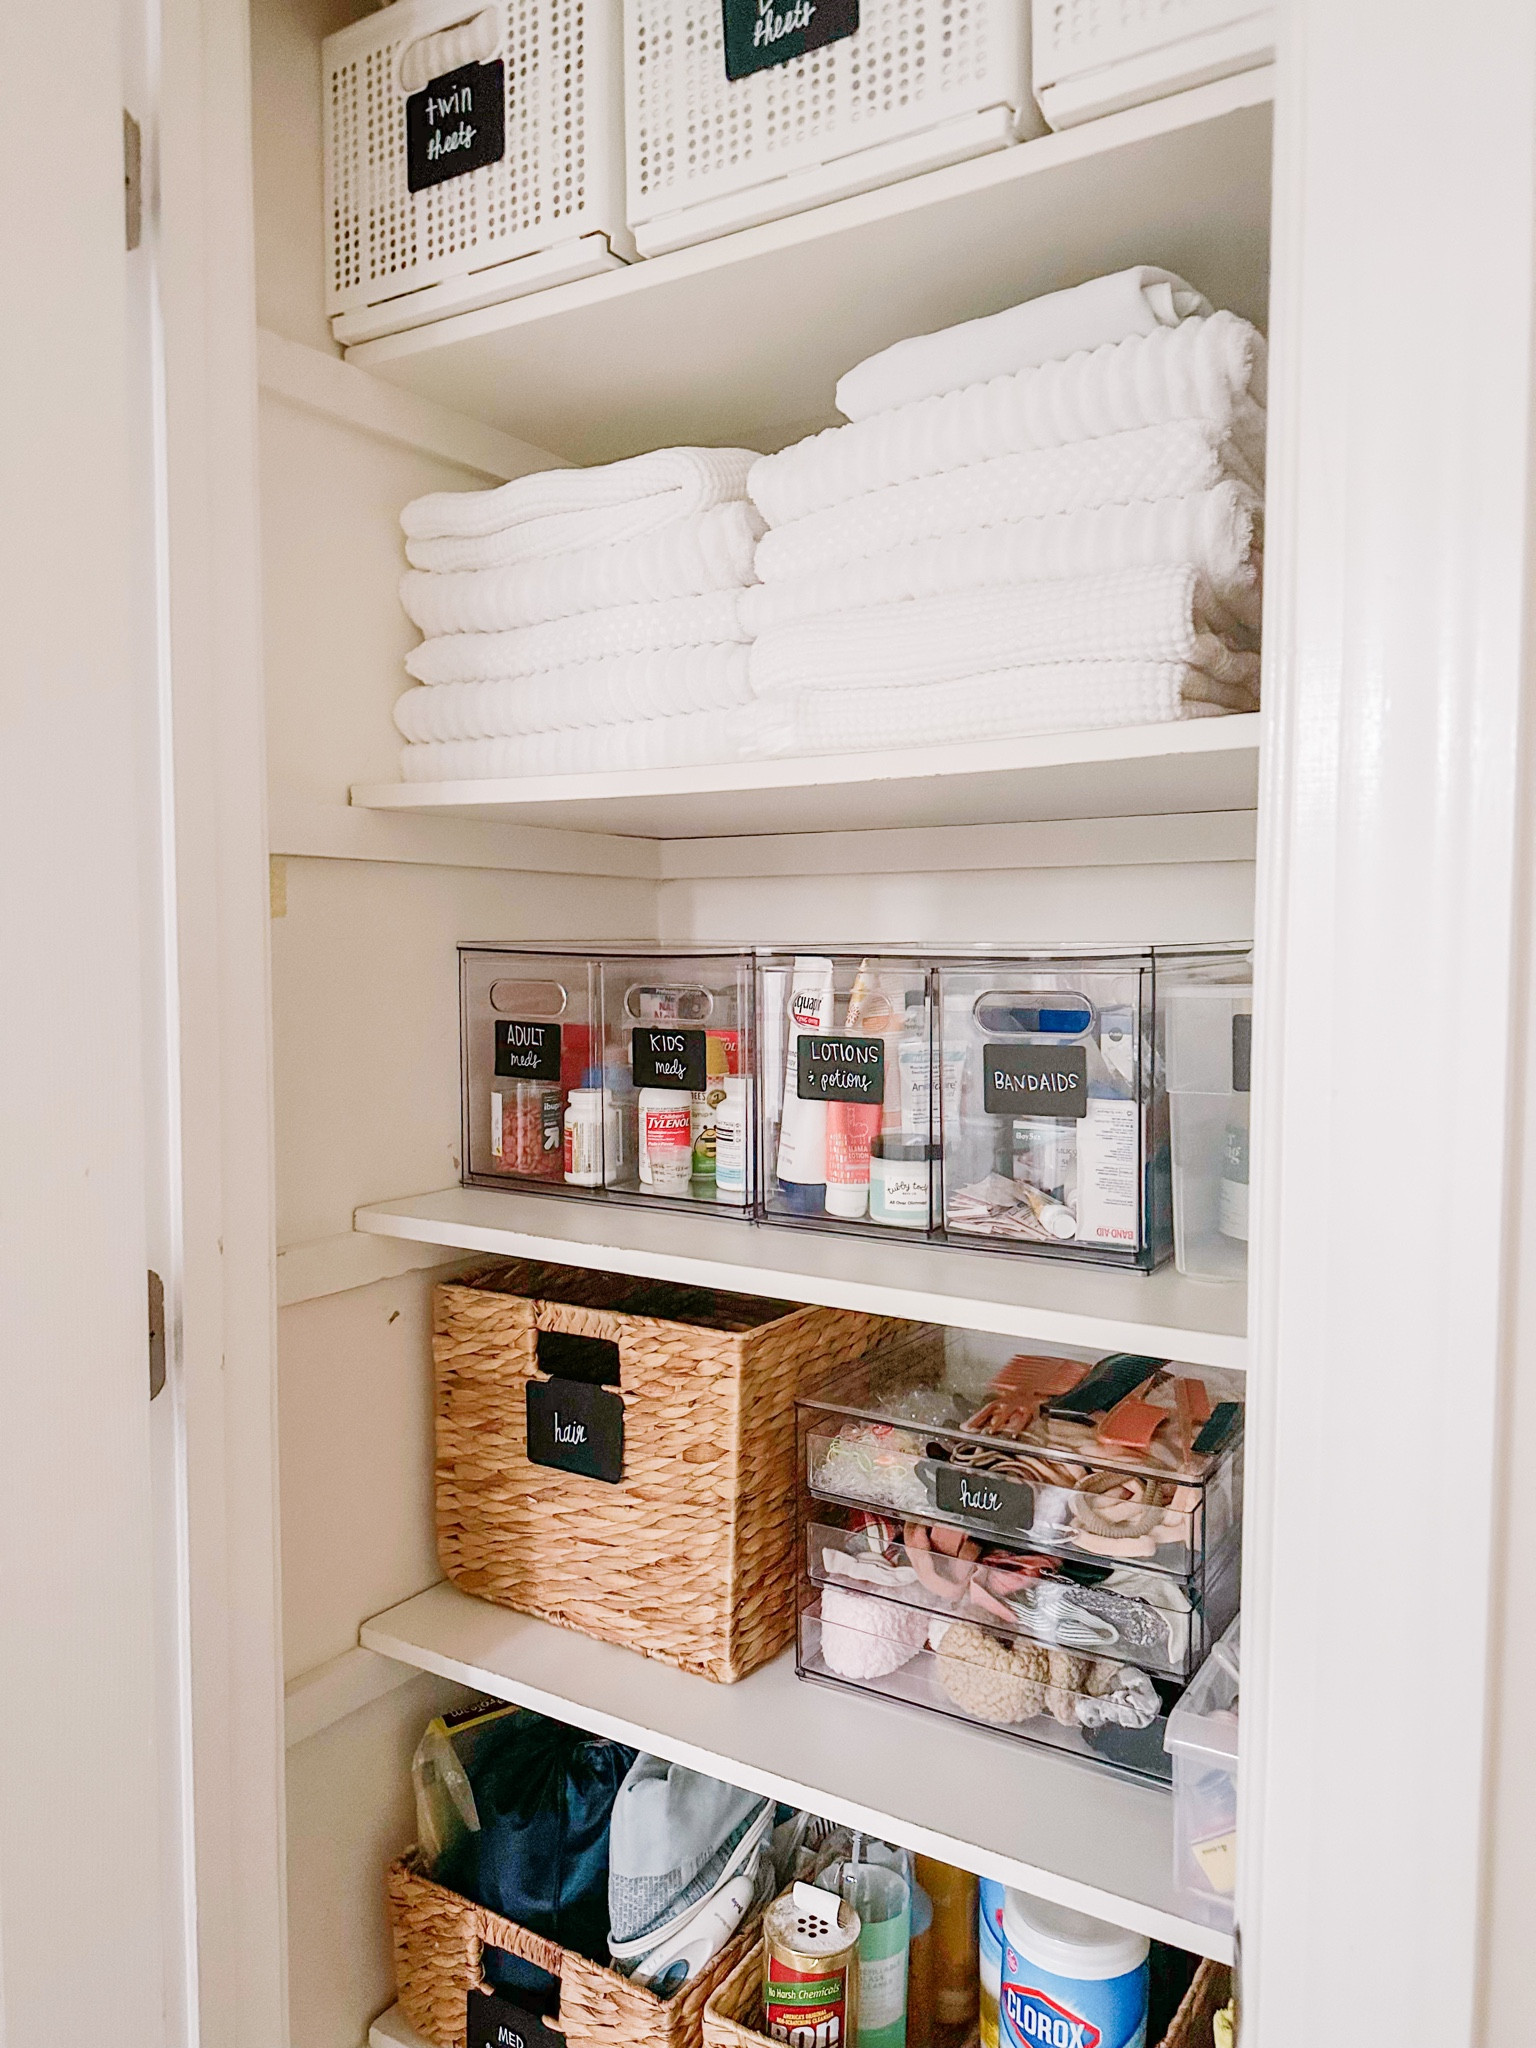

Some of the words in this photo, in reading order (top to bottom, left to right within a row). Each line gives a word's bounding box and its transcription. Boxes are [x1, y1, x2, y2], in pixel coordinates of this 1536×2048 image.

[425, 84, 473, 126] twin
[427, 120, 477, 160] sheets
[507, 1024, 545, 1046] ADULT
[649, 1033, 685, 1052] KIDS
[510, 1050, 542, 1069] meds
[811, 1041, 879, 1064] LOTIONS
[655, 1058, 687, 1080] meds
[820, 1069, 873, 1092] potions
[994, 1071, 1079, 1092] BANDAIDS
[647, 1117, 690, 1129] TYLENOL
[554, 1411, 588, 1445] hair
[959, 1479, 1003, 1511] hair
[768, 1986, 776, 1998] No
[776, 1989, 797, 2000] Harsh
[798, 1983, 840, 1999] Chemicals
[1007, 1988, 1085, 2048] CLOROX
